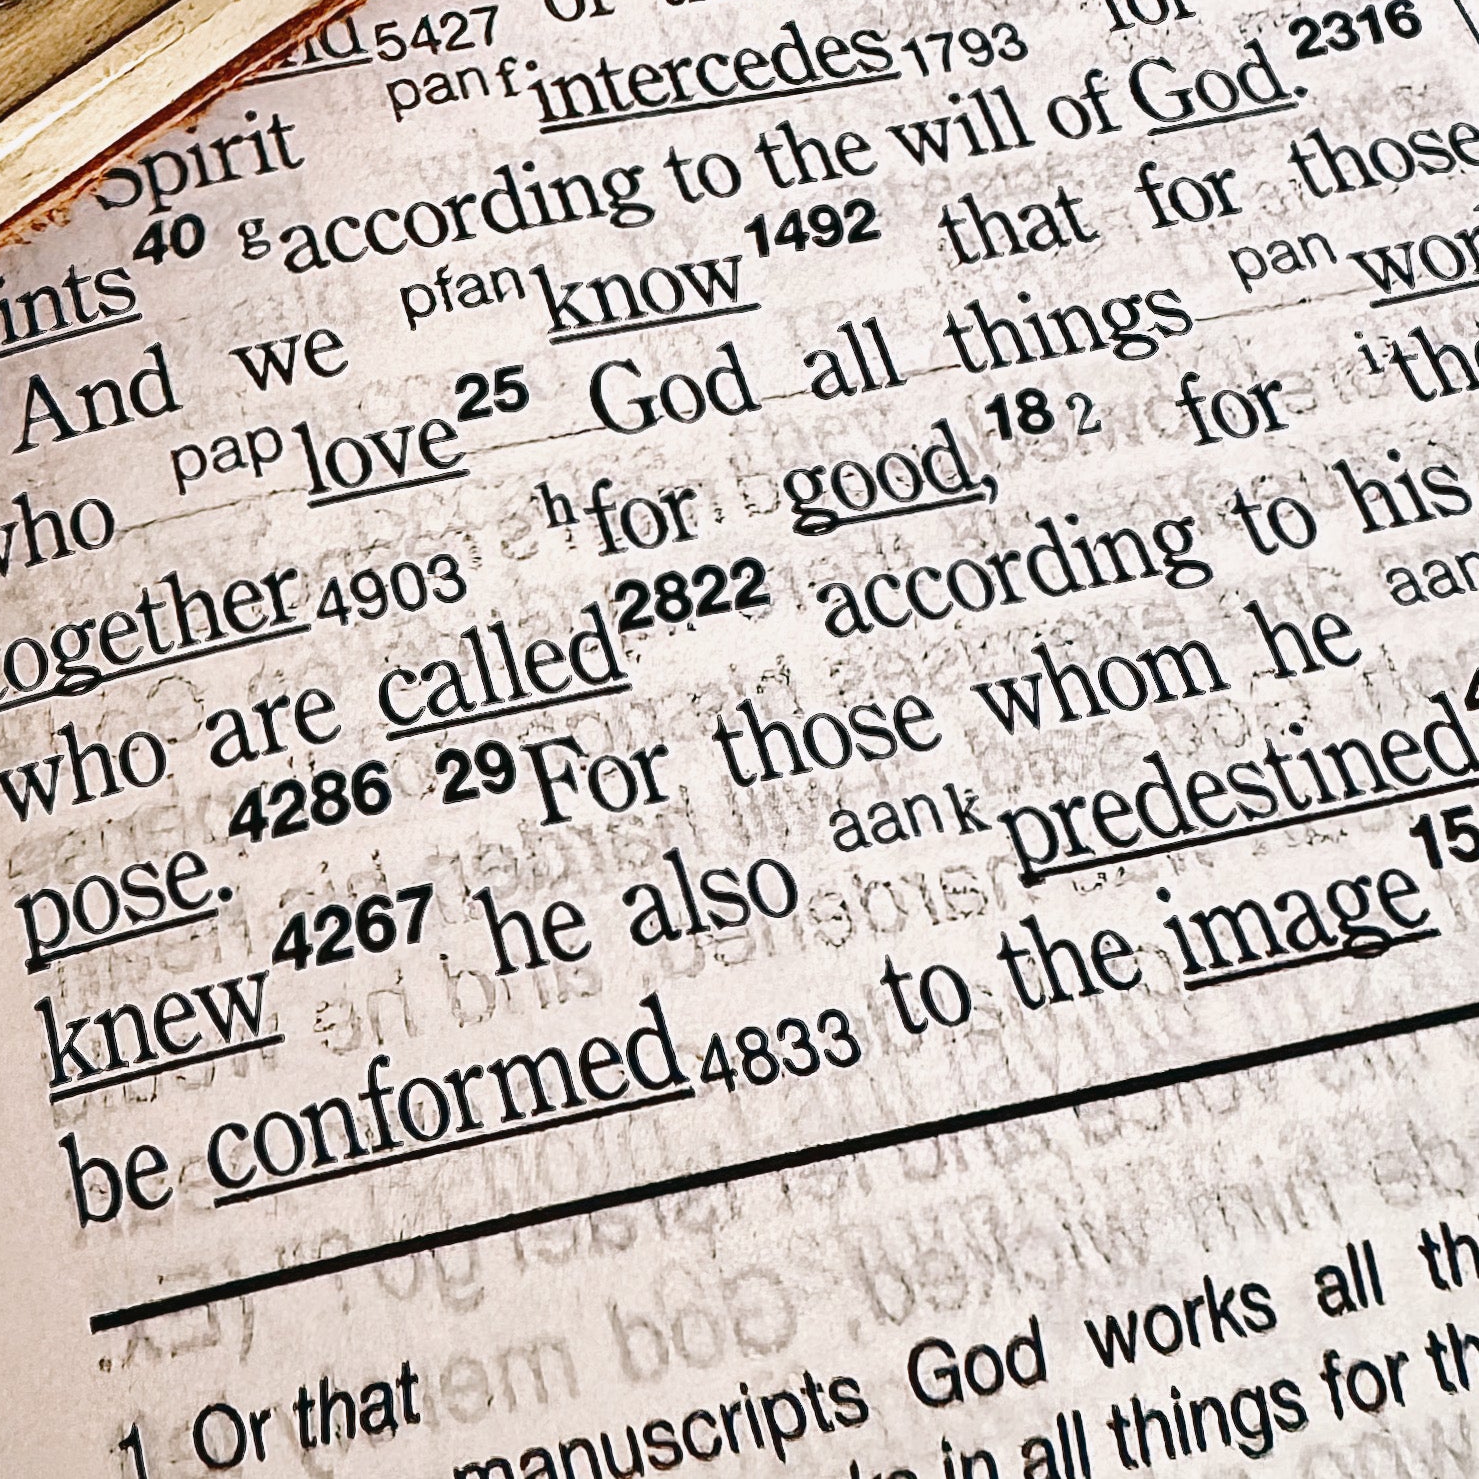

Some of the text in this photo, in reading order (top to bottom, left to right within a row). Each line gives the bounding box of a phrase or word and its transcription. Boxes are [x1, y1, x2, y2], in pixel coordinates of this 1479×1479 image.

[279, 160, 656, 274] according
[663, 146, 743, 206] to
[755, 121, 879, 189] the
[886, 84, 1036, 167] will
[1046, 69, 1122, 140] of
[1128, 39, 1309, 124] God.
[524, 20, 896, 125] intercedes
[12, 122, 1479, 456] And we know 1492 that for those
[589, 341, 763, 436] God
[803, 317, 908, 402] all
[943, 288, 1194, 375] things
[206, 686, 342, 768] are
[379, 601, 628, 726] called
[613, 557, 771, 633] 2822
[817, 513, 1214, 637] according
[1231, 488, 1318, 556] to
[1333, 449, 1473, 534] his
[318, 552, 468, 625] 4903
[783, 418, 1000, 536] good,
[1176, 371, 1290, 447] for
[15, 599, 1362, 973] pose. 4286 those whom he
[34, 690, 1479, 1090] knew 4267 he also predestined
[59, 866, 1432, 1228] be conformed 4833 to the image
[193, 1361, 420, 1469] Or that
[908, 1315, 1048, 1409] God
[1083, 1275, 1278, 1368] works
[1314, 1240, 1383, 1319] all
[1107, 1346, 1409, 1460] things for
